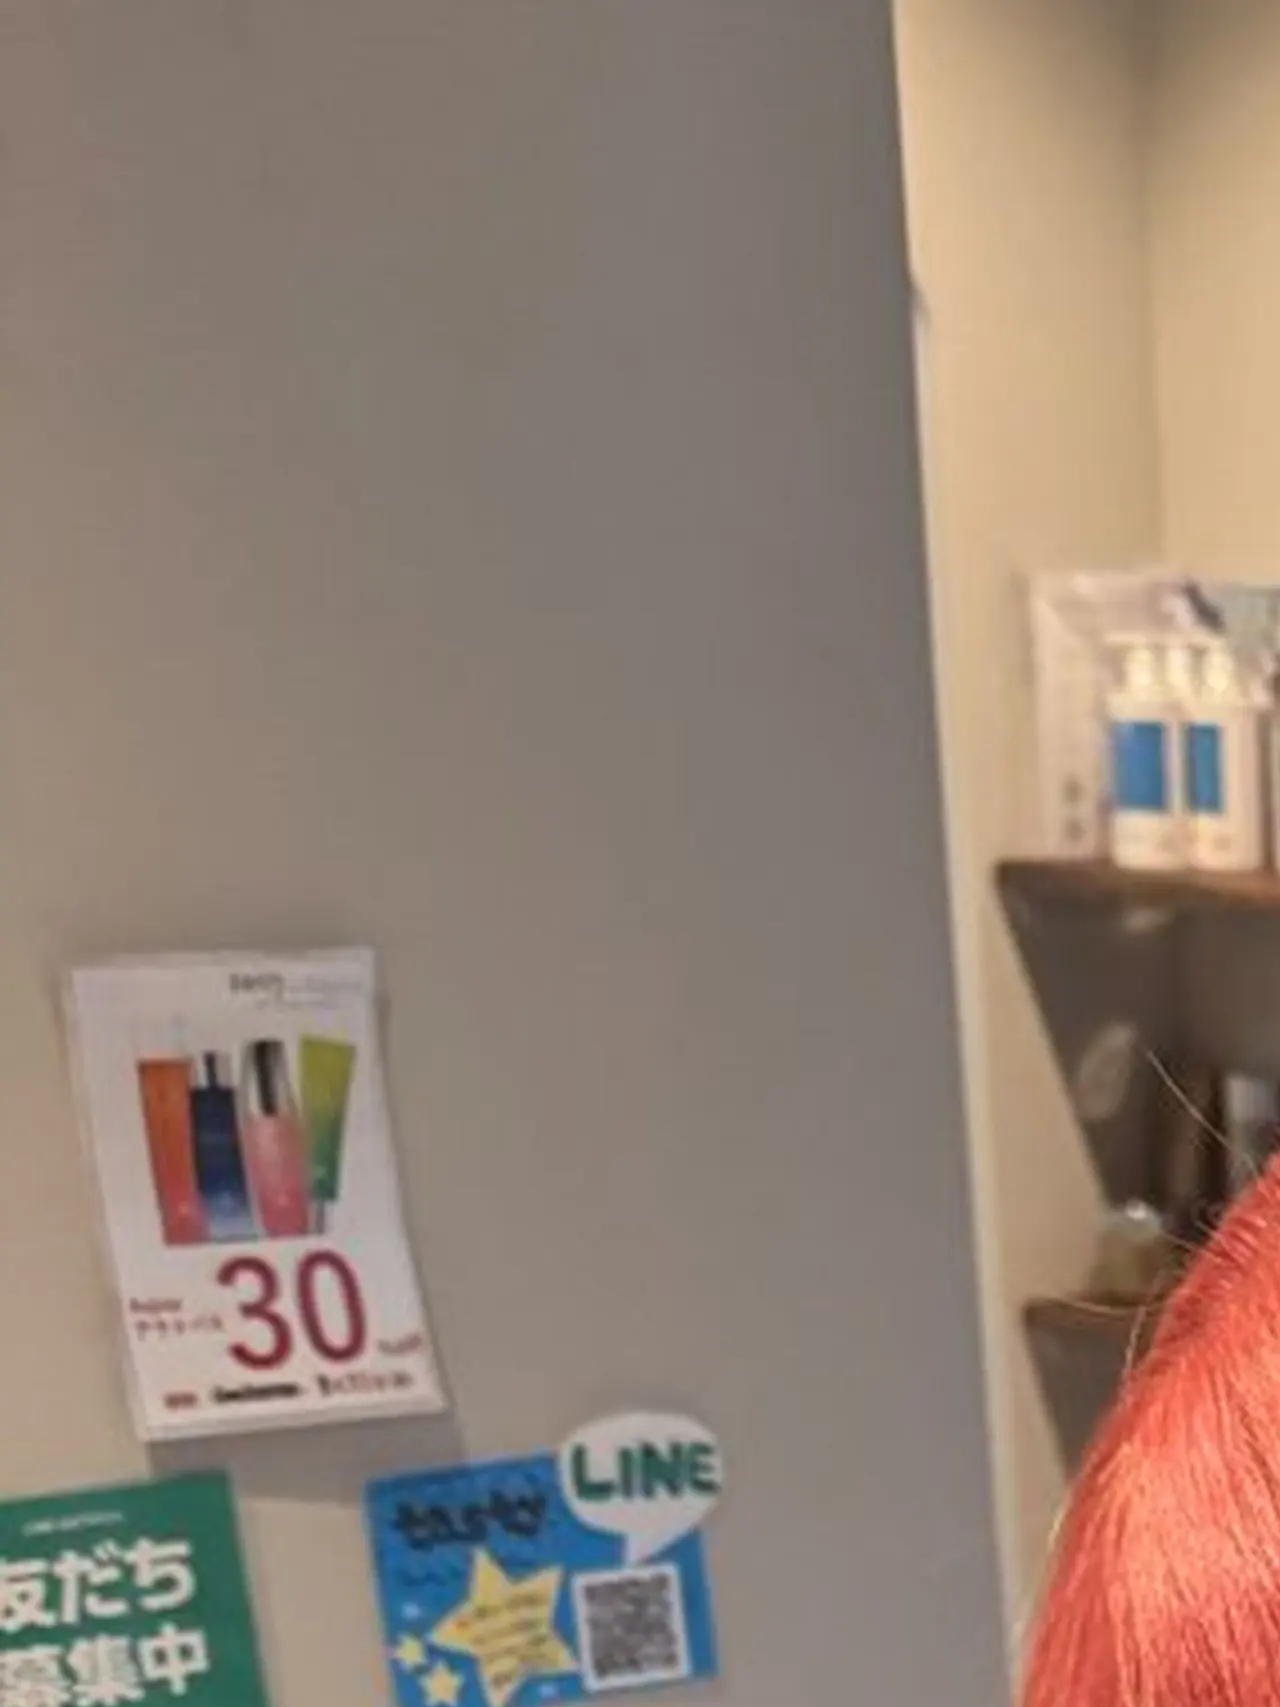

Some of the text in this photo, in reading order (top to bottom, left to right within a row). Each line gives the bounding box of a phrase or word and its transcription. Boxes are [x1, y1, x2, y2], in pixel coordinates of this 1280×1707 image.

[216, 1249, 367, 1370] 30
[569, 1440, 723, 1502] LINE
[0, 1537, 197, 1632] 友だち
